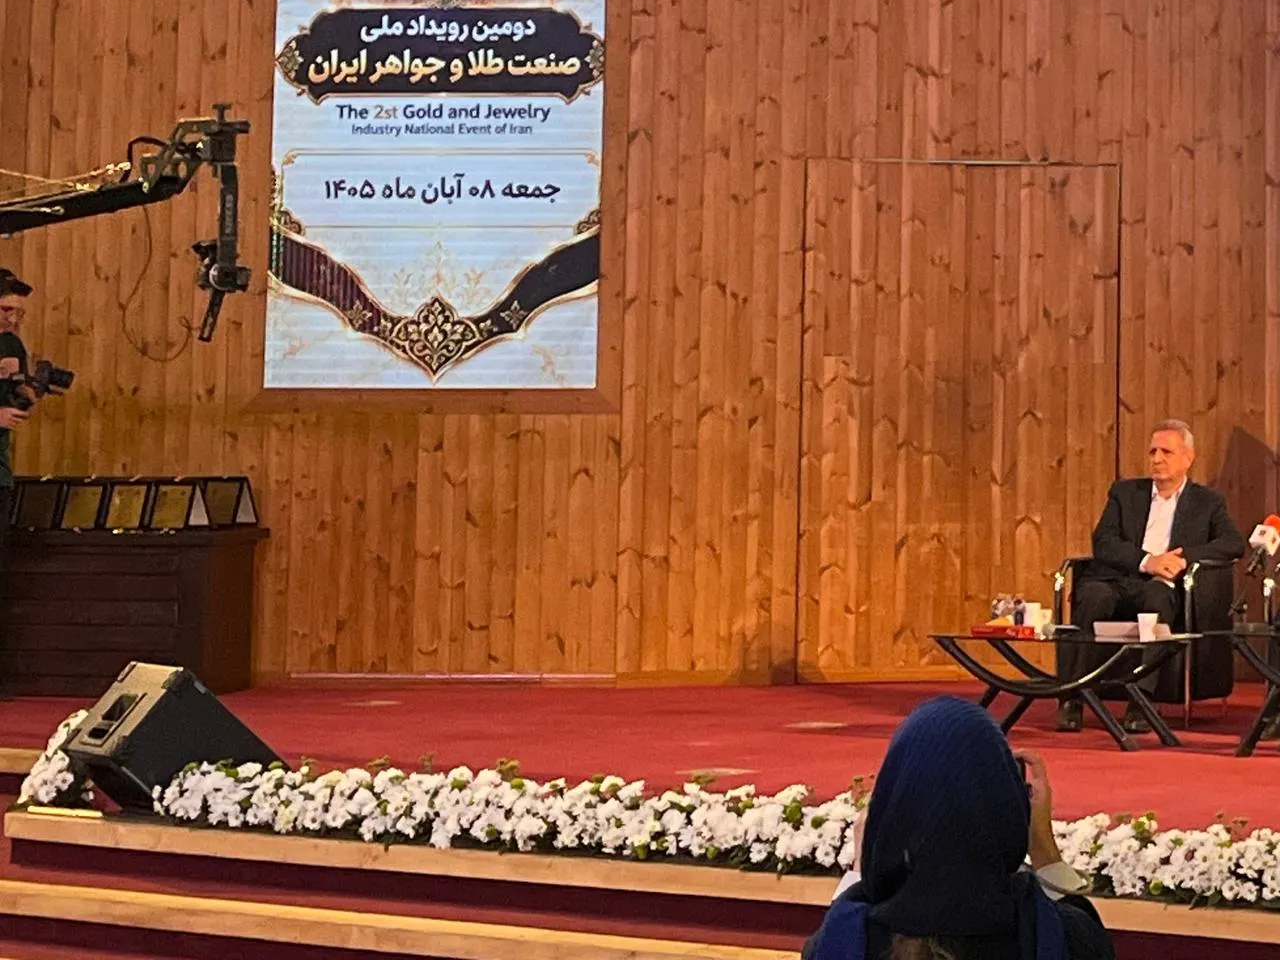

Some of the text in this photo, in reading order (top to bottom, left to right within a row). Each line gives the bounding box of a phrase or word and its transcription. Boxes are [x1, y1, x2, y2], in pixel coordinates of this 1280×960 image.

[360, 14, 536, 41] دومین رویداد ملی
[308, 48, 581, 84] صنعت طلا و جواهر ایران
[336, 103, 550, 122] The 2st Gold and Jewelry
[351, 123, 533, 137] Industry National Event of Iran
[324, 174, 561, 205] جمعه ۰۸ آبان ماه ۱۴۰۵
